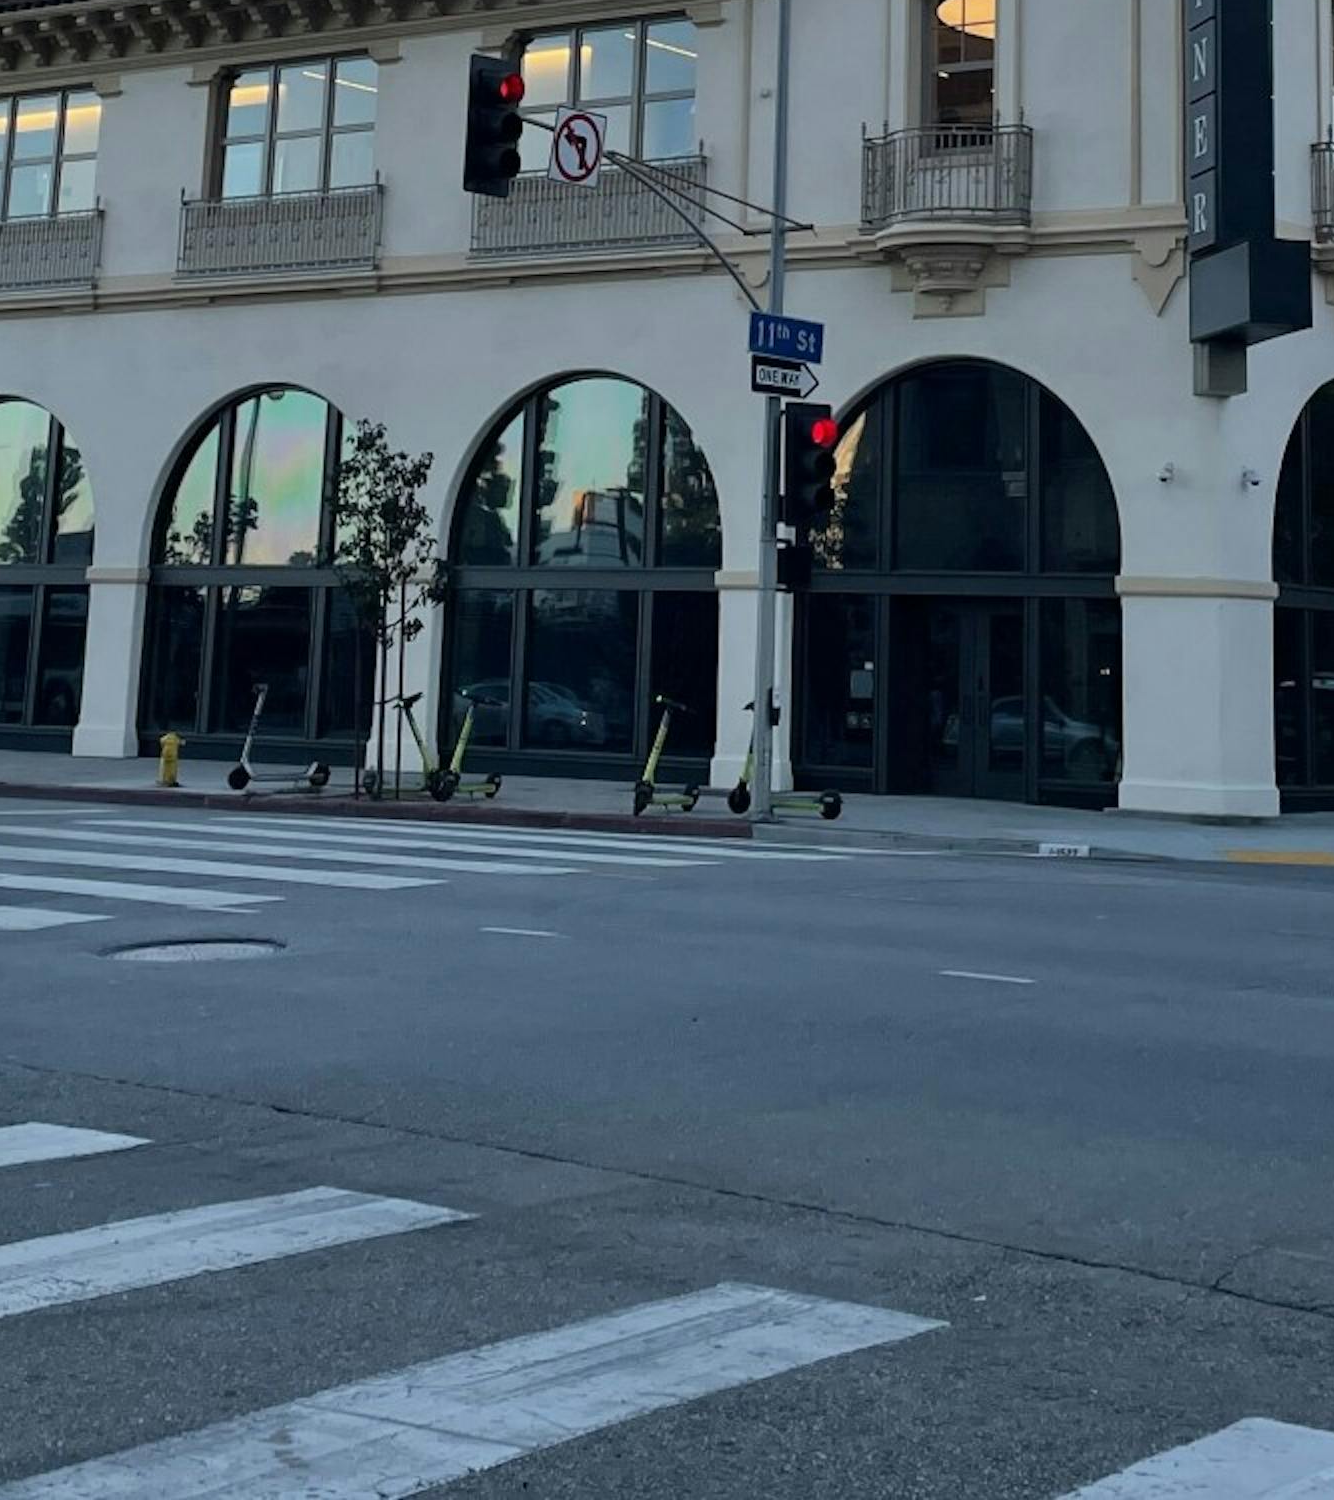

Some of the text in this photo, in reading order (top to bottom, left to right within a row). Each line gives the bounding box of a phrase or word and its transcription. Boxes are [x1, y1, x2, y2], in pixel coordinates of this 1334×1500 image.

[757, 319, 816, 354] 11th St
[758, 367, 800, 387] ONE WAY
